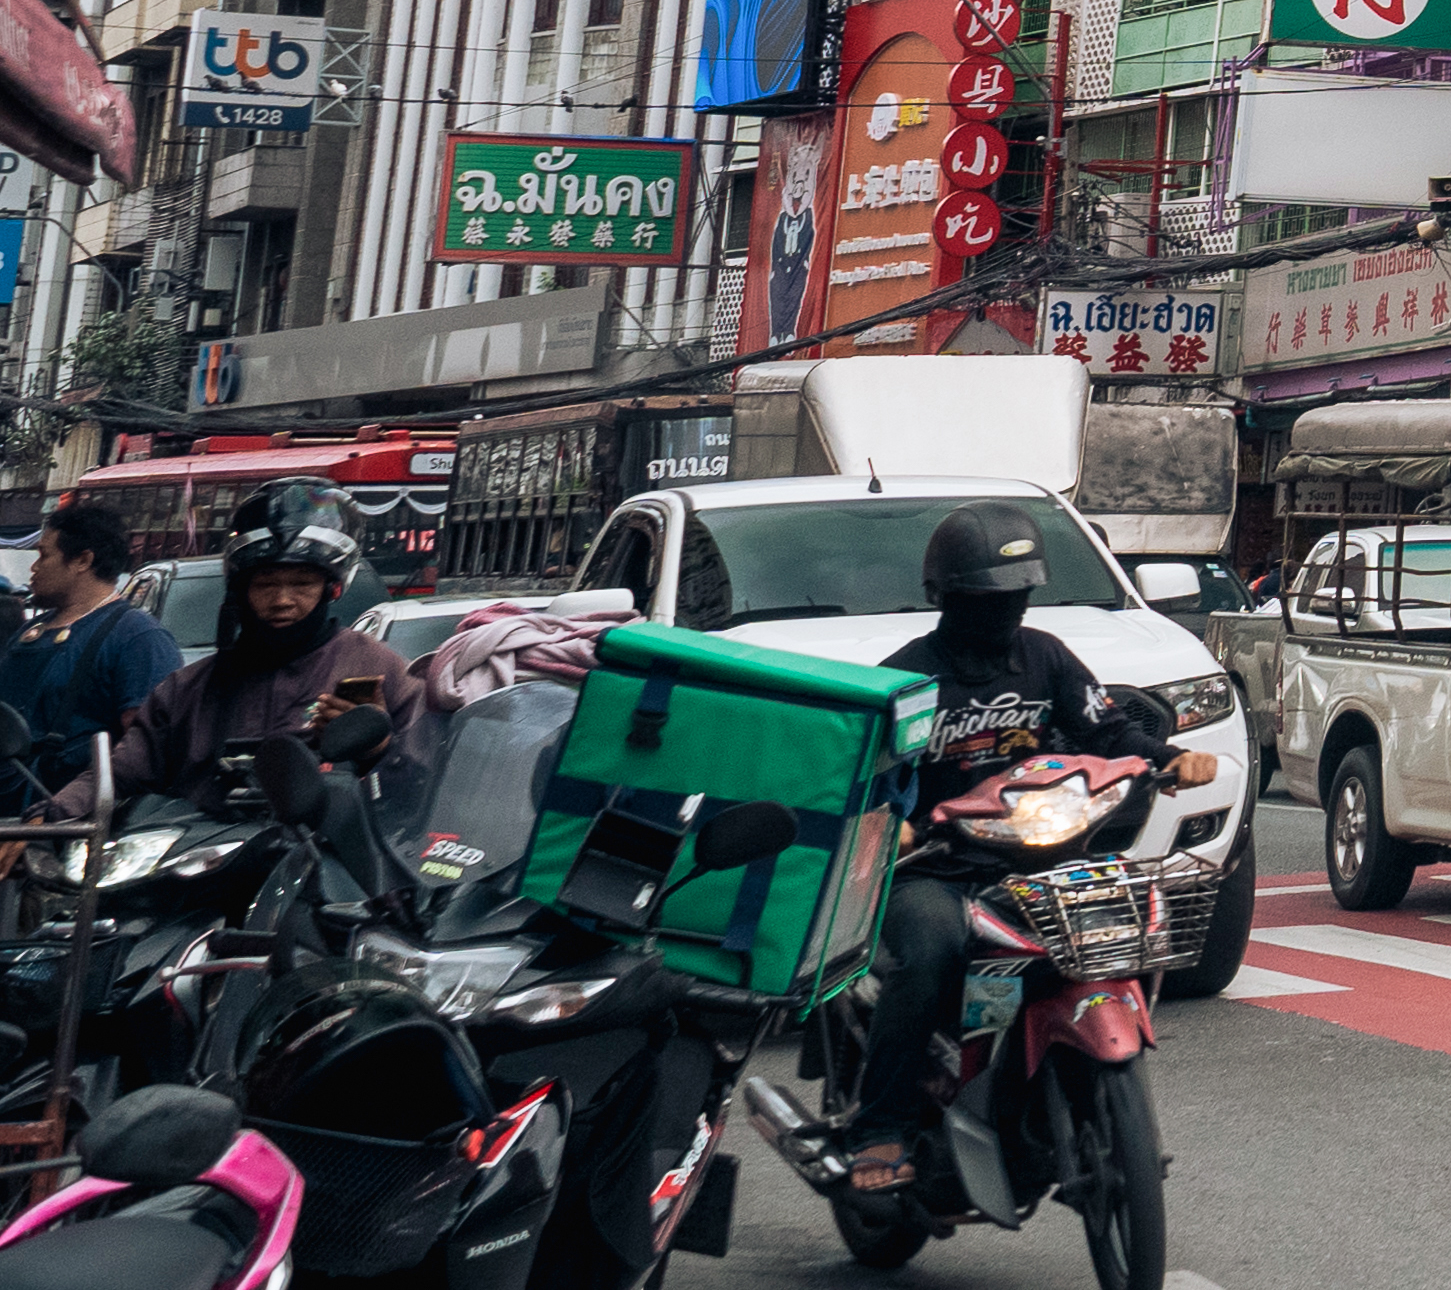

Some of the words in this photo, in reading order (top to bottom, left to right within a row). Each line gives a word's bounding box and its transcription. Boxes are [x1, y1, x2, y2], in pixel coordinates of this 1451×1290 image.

[205, 26, 310, 80] ttb
[232, 107, 284, 127] 1428
[455, 146, 676, 218] ฉ.มั่นคง
[466, 1229, 531, 1260] HONDA
